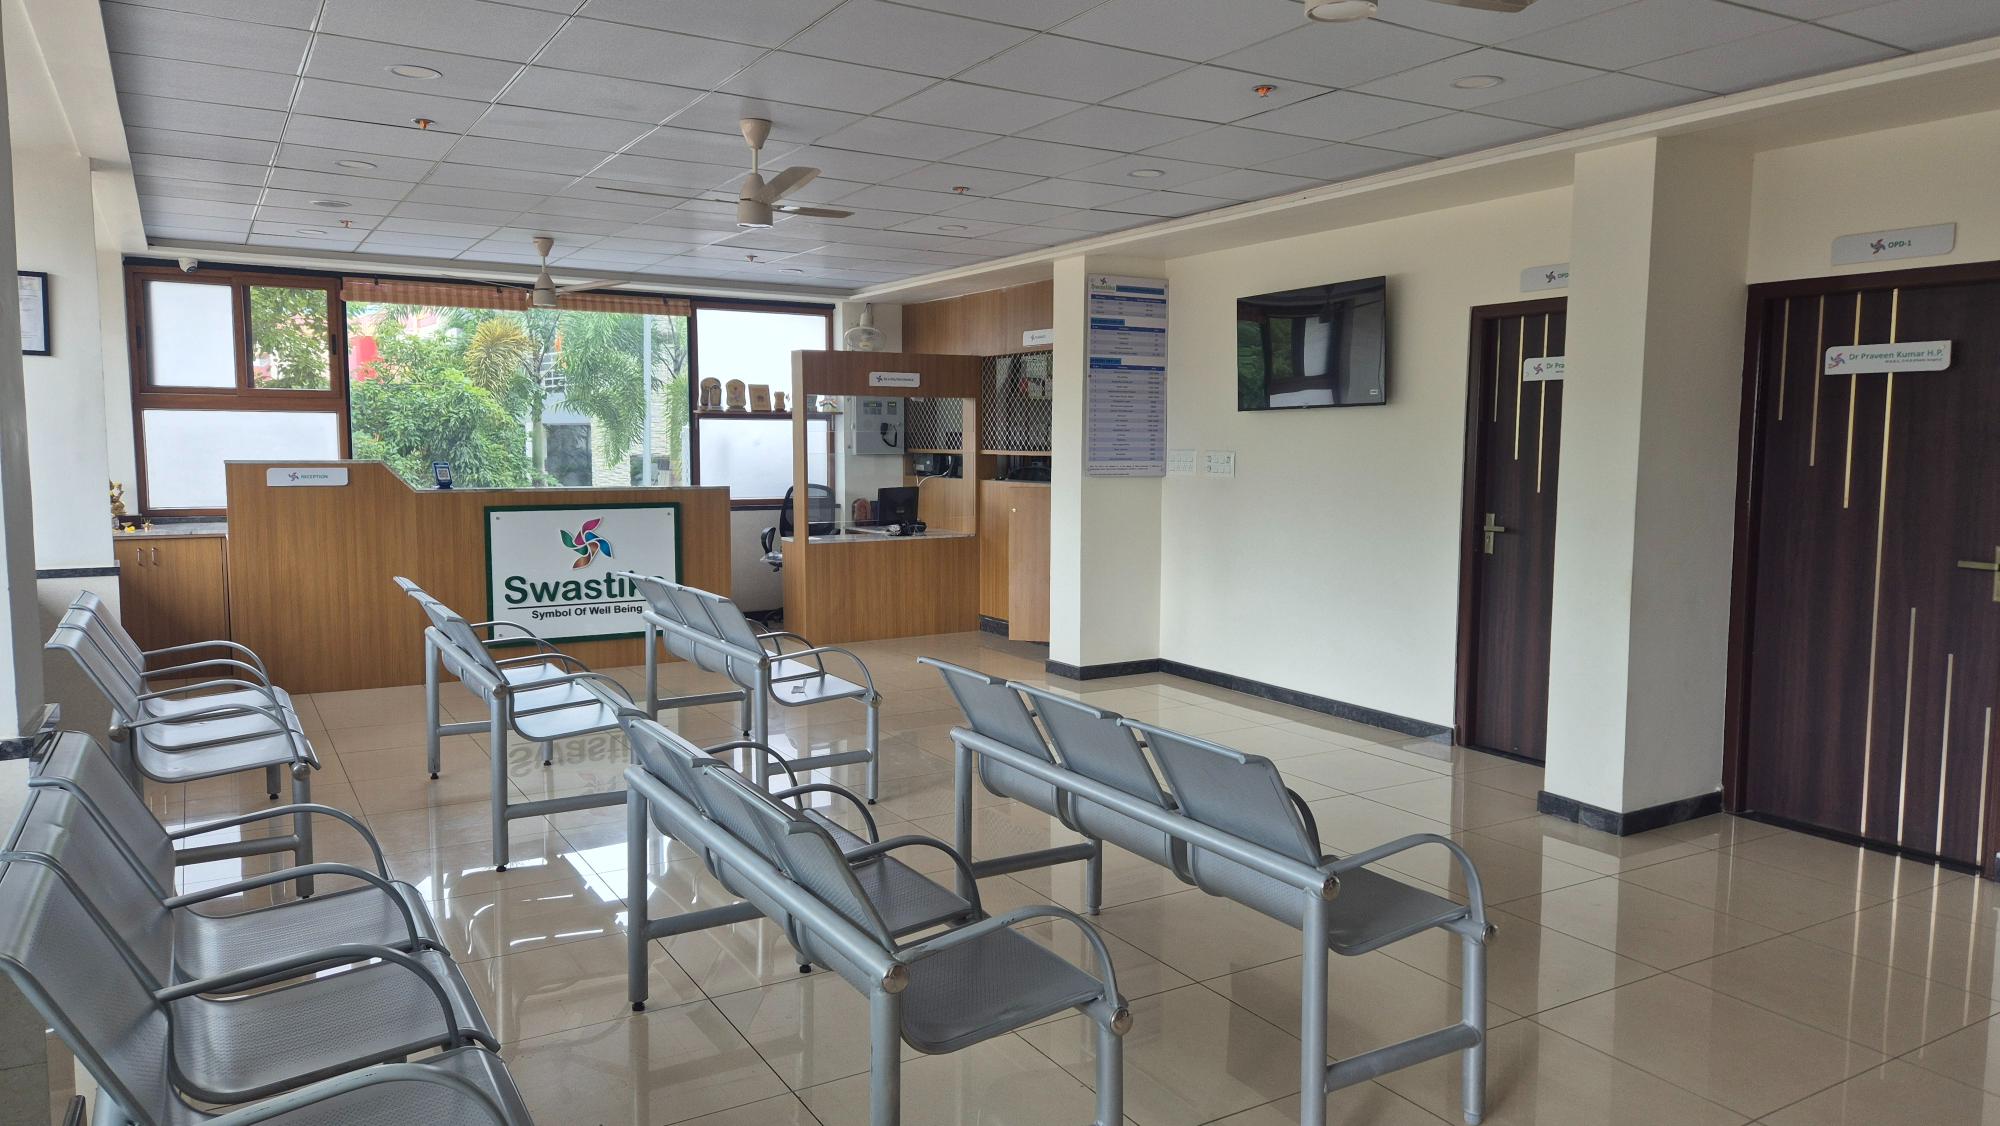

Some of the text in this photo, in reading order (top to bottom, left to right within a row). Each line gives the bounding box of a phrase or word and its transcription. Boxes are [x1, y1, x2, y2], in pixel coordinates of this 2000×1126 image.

[1887, 240, 1912, 249] OPD-1
[1848, 353, 1859, 361] Dr
[1860, 351, 1894, 360] Praveen
[1896, 350, 1925, 359] Kumar
[504, 570, 664, 605] Swastik
[531, 604, 643, 621] Symbol Of Well Being
